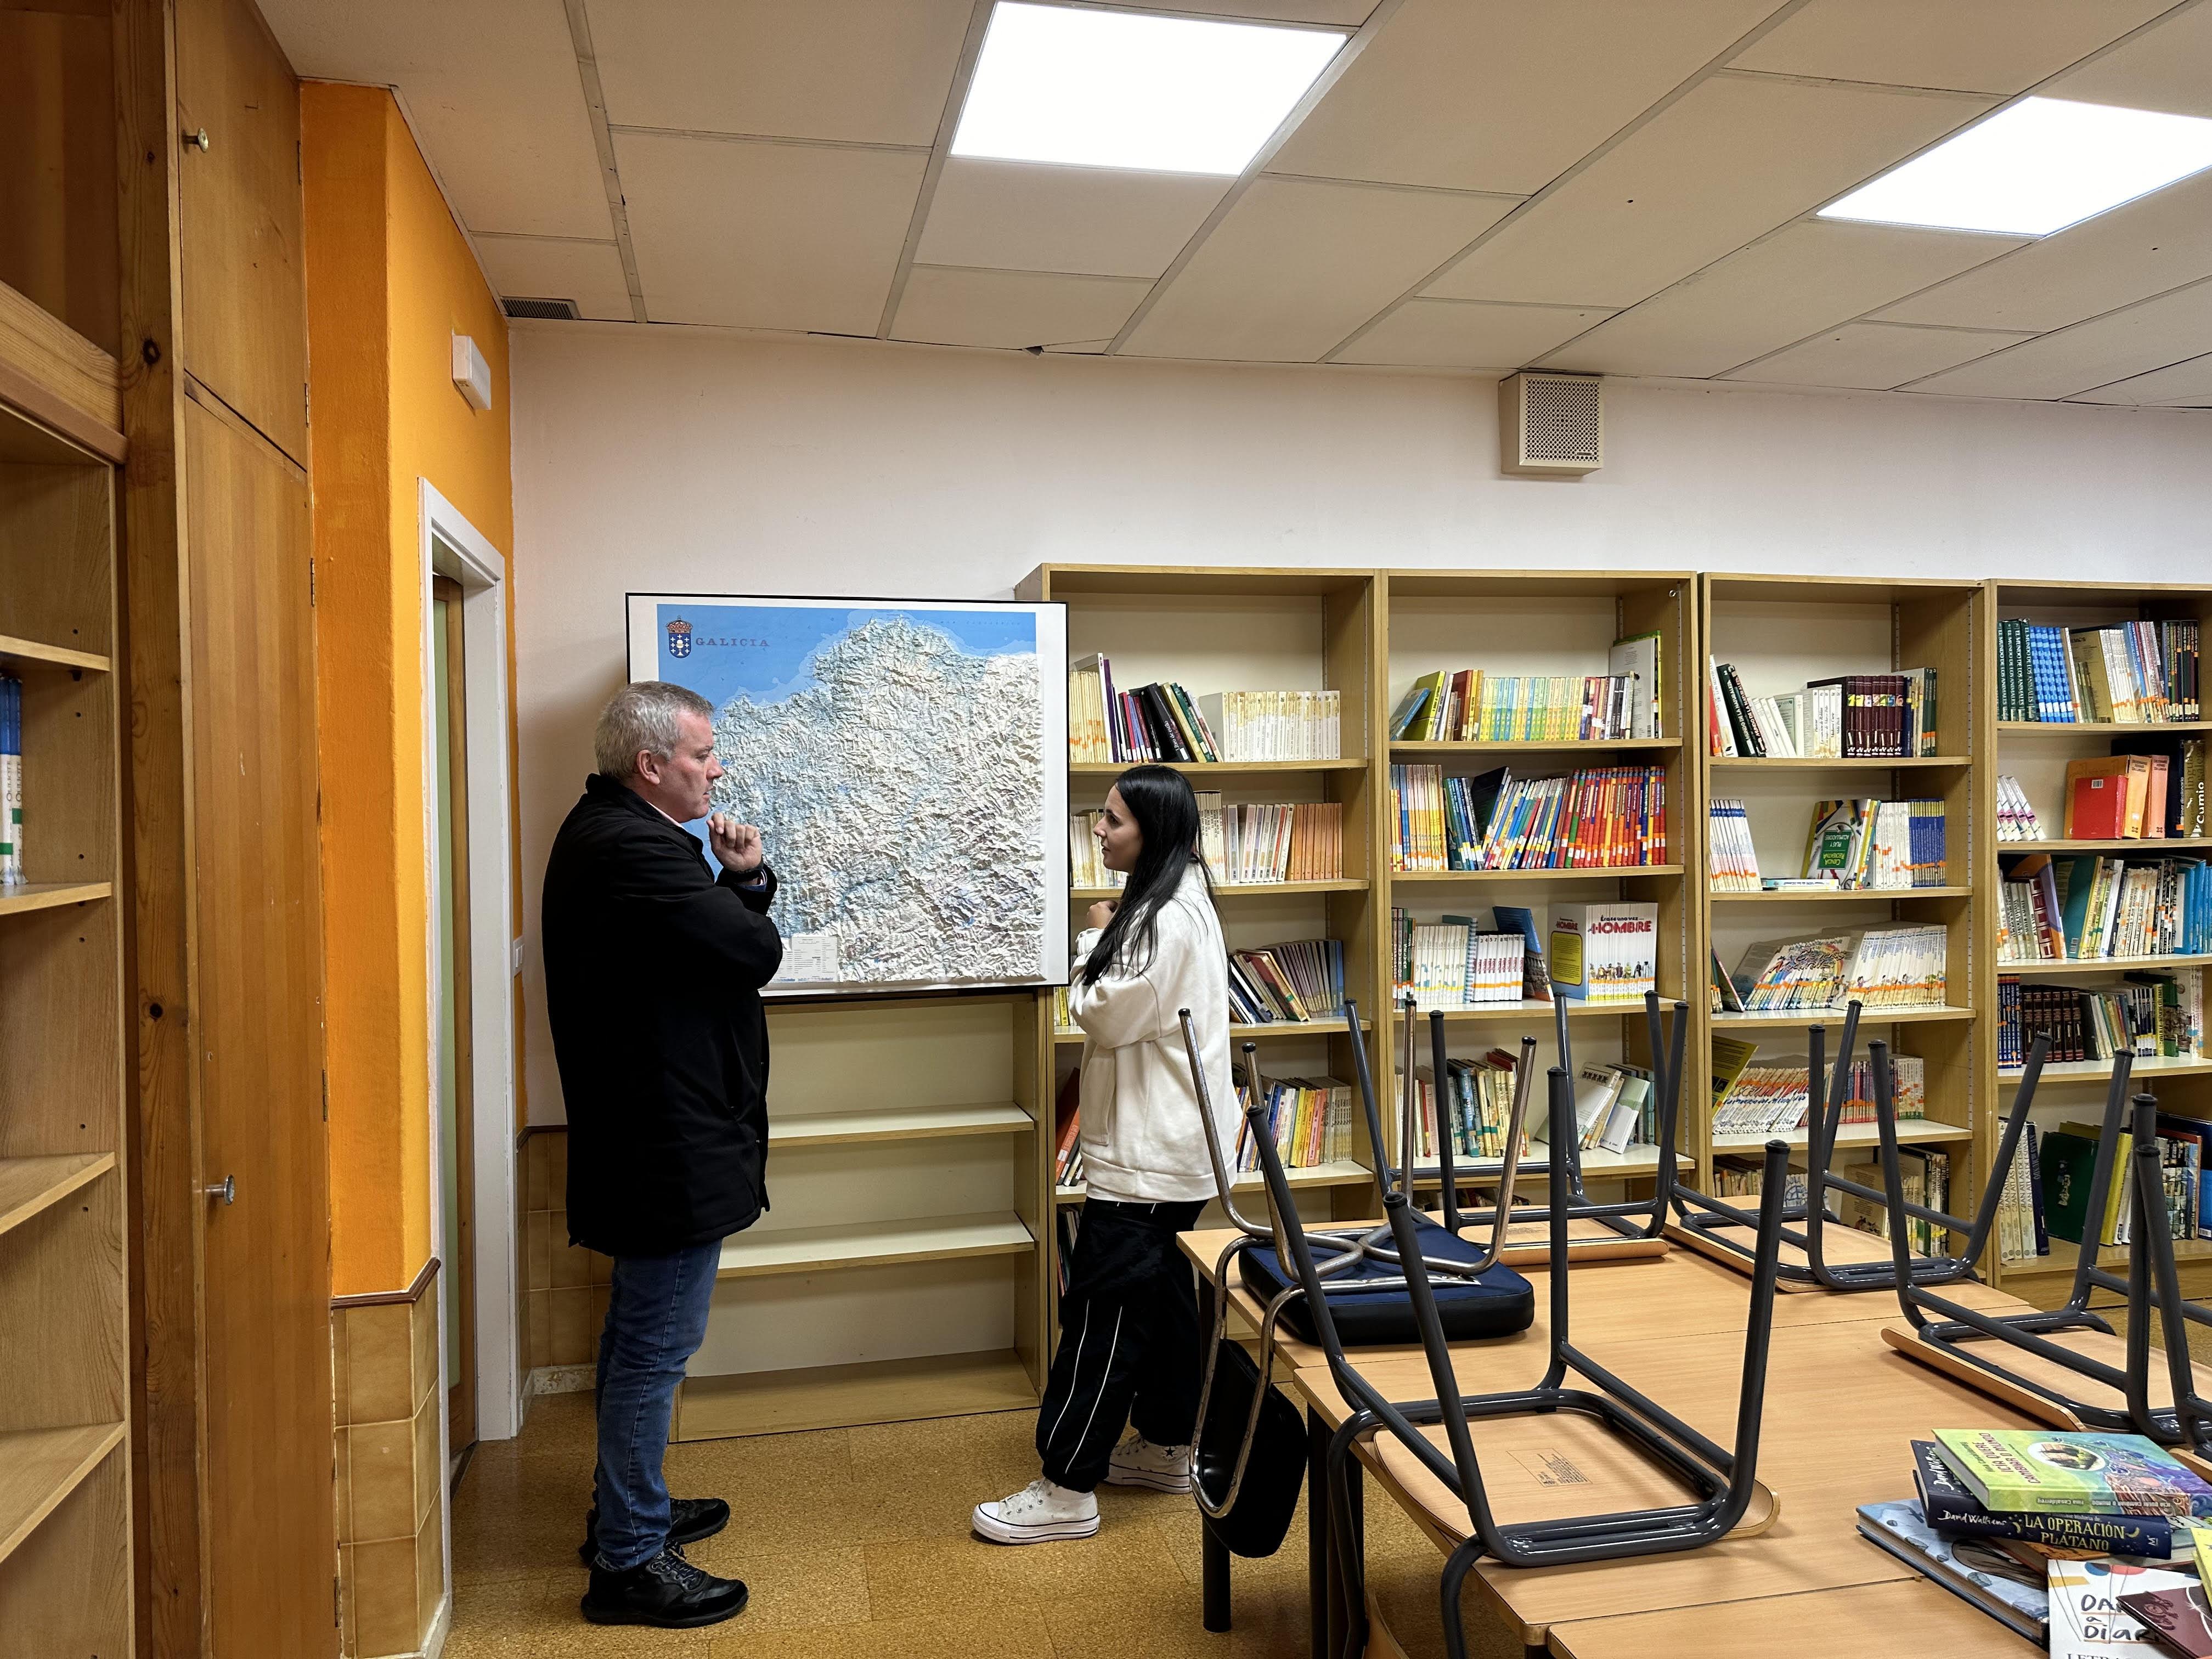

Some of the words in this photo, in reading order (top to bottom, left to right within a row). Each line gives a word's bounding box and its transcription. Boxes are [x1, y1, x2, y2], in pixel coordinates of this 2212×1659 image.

[695, 637, 770, 647] GALICIA
[1164, 720, 1172, 732] estilo
[2196, 782, 2204, 824] Cumio
[1590, 920, 1652, 935] HOMBRE
[1972, 1442, 1999, 1459] QUERE
[1978, 1432, 2008, 1454] MUNDO
[2005, 1459, 2041, 1484] CAMBIAR
[1937, 1510, 1968, 1524] David
[1968, 1514, 2007, 1526] Walliams
[2024, 1514, 2044, 1530] LA
[2047, 1517, 2125, 1539] OPERACIÓN
[2041, 1532, 2110, 1551] PLÁTANO
[2081, 1594, 2123, 1613] DA
